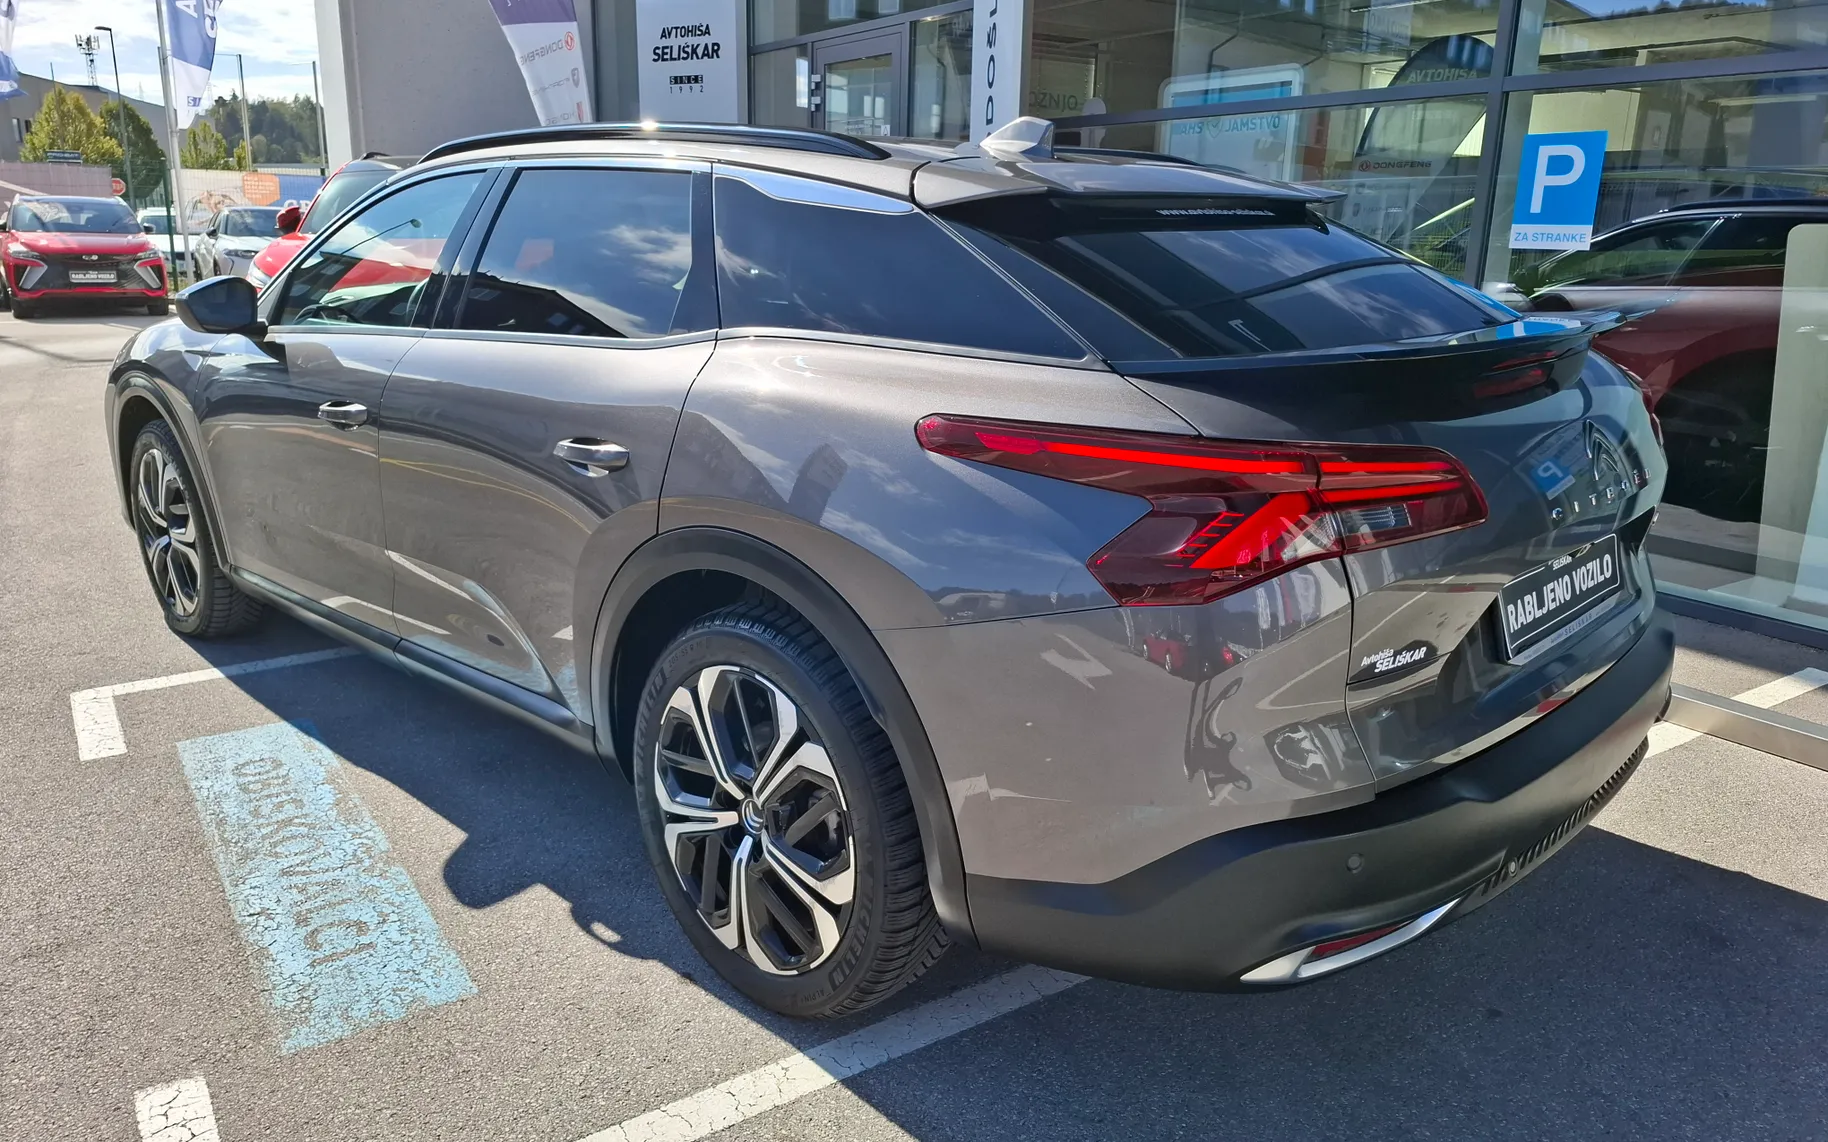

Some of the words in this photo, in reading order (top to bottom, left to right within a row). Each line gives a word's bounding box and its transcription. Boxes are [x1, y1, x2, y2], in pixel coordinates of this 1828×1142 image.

[660, 22, 711, 40] AVTOHIŠA
[652, 41, 721, 63] SELIŠKAR
[670, 75, 703, 85] SINCE
[670, 85, 704, 94] 1992
[1180, 121, 1205, 135] AHS
[1224, 115, 1281, 133] JAMSTVO
[1530, 144, 1586, 214] P
[1514, 232, 1529, 242] ZA
[1531, 233, 1587, 243] STRANKE
[1507, 577, 1572, 634] RABLJENO
[1571, 553, 1613, 596] VOZILO
[1361, 648, 1394, 667] Avtohiša
[1374, 646, 1427, 673] SELIŠKAR
